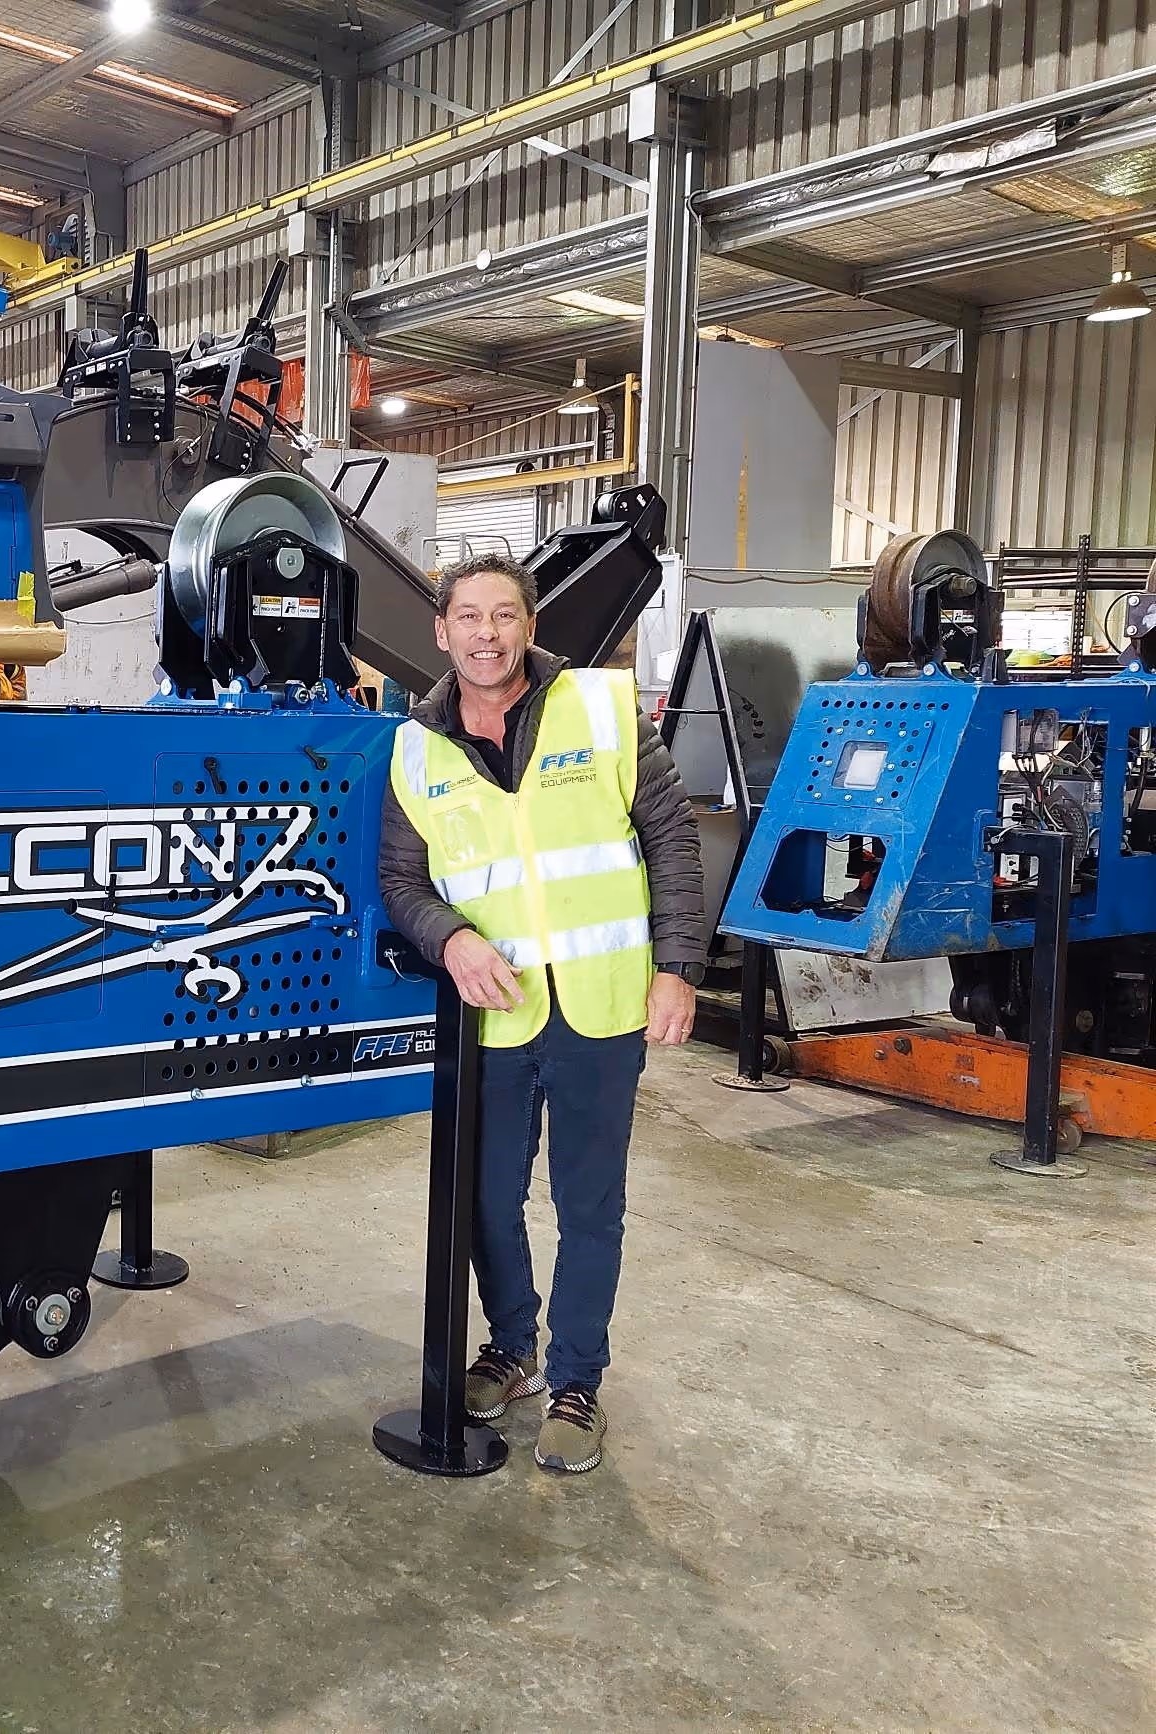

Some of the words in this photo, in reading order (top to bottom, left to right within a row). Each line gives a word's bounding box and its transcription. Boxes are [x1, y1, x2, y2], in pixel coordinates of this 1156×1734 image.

[540, 747, 594, 772] FFE
[540, 774, 597, 788] EQUIPMENT
[353, 1031, 415, 1063] FFE
